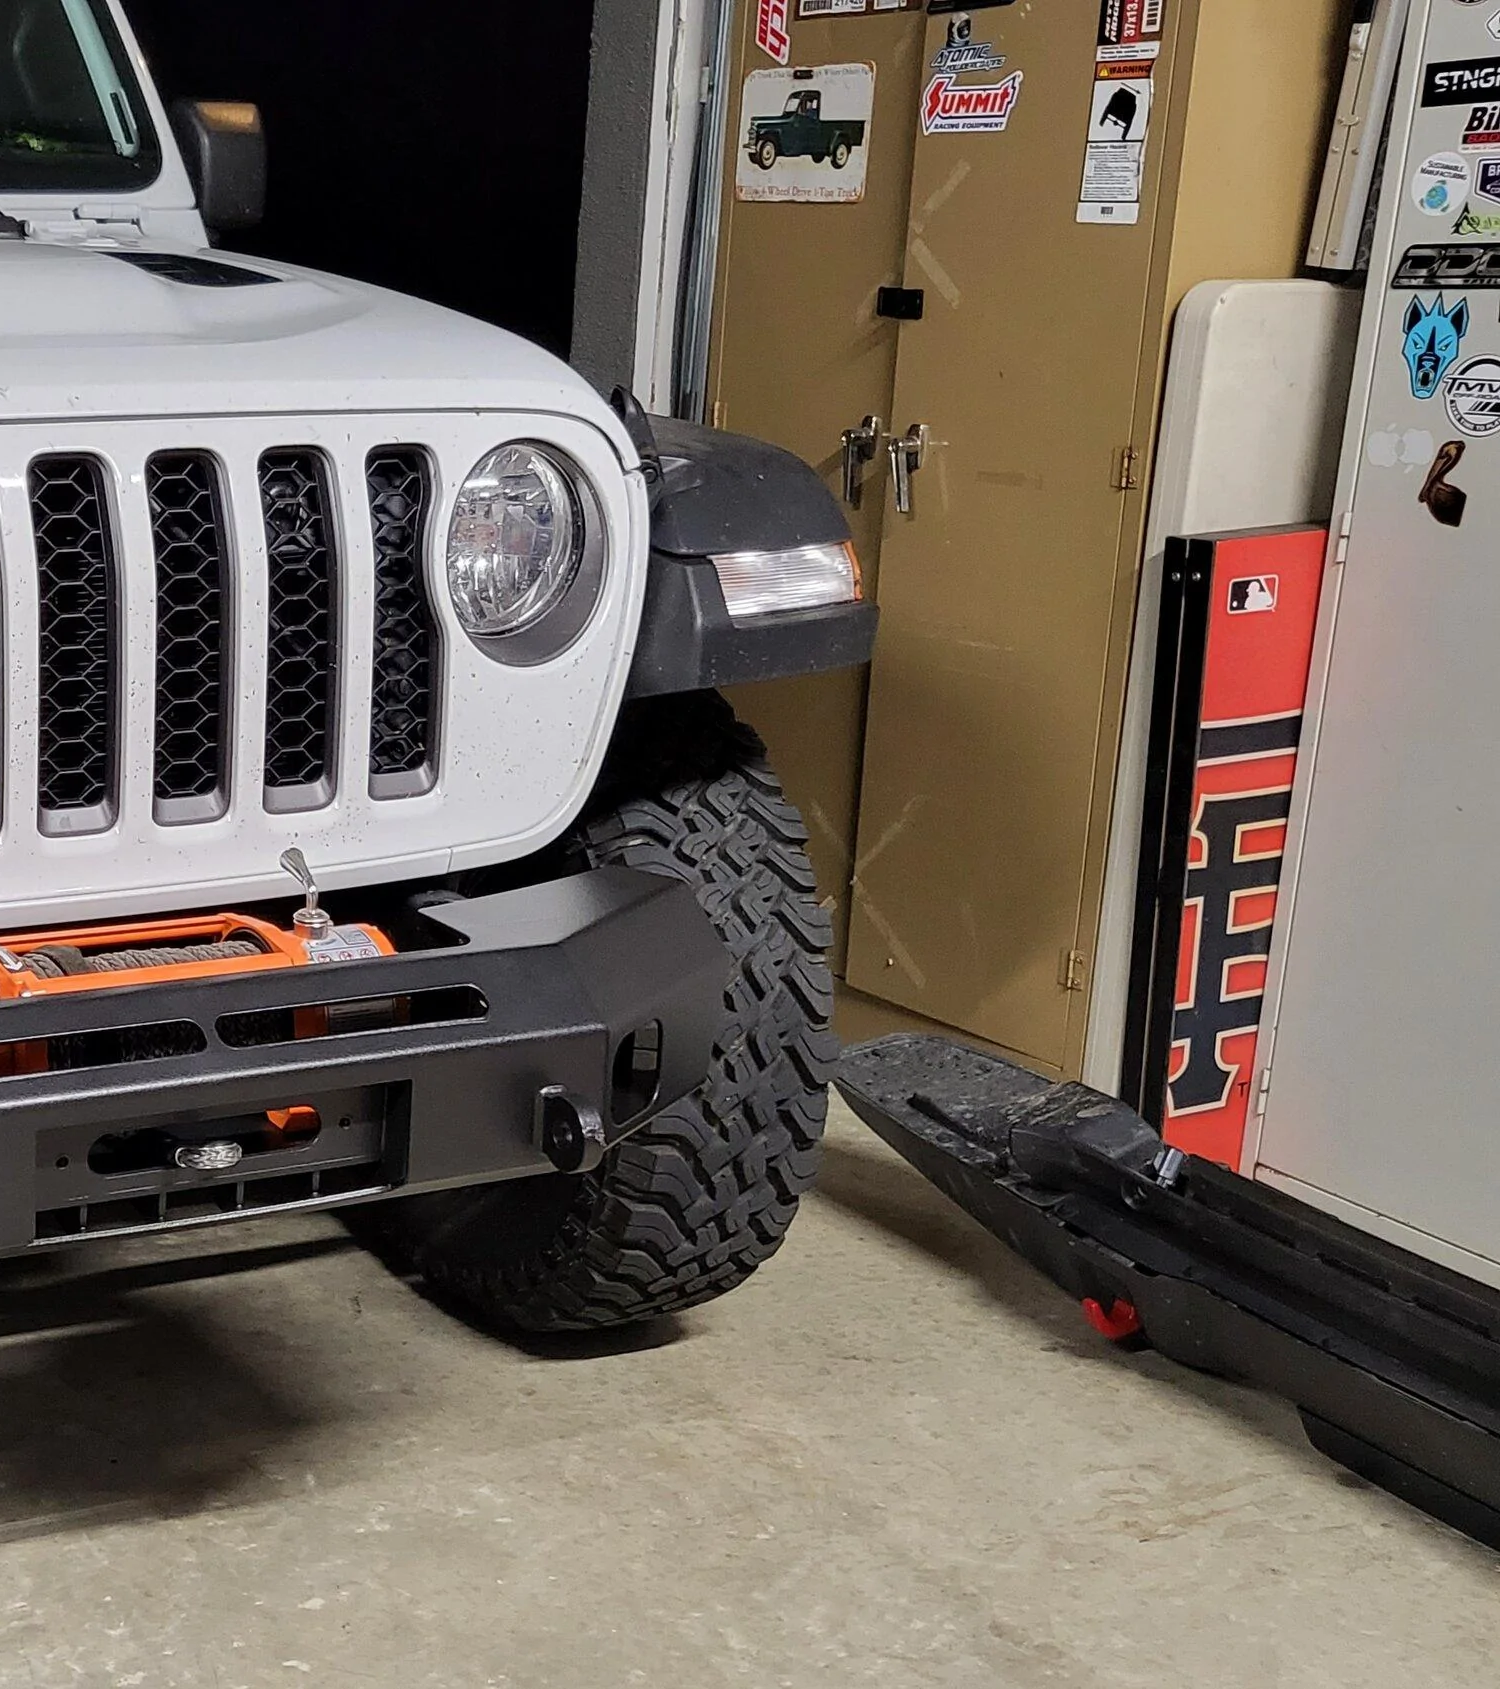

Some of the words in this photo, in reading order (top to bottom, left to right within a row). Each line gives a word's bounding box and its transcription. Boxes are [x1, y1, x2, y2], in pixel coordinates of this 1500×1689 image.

[1433, 66, 1500, 92] STNG
[934, 122, 960, 130] RACING
[962, 121, 1004, 130] EQUIPMENT
